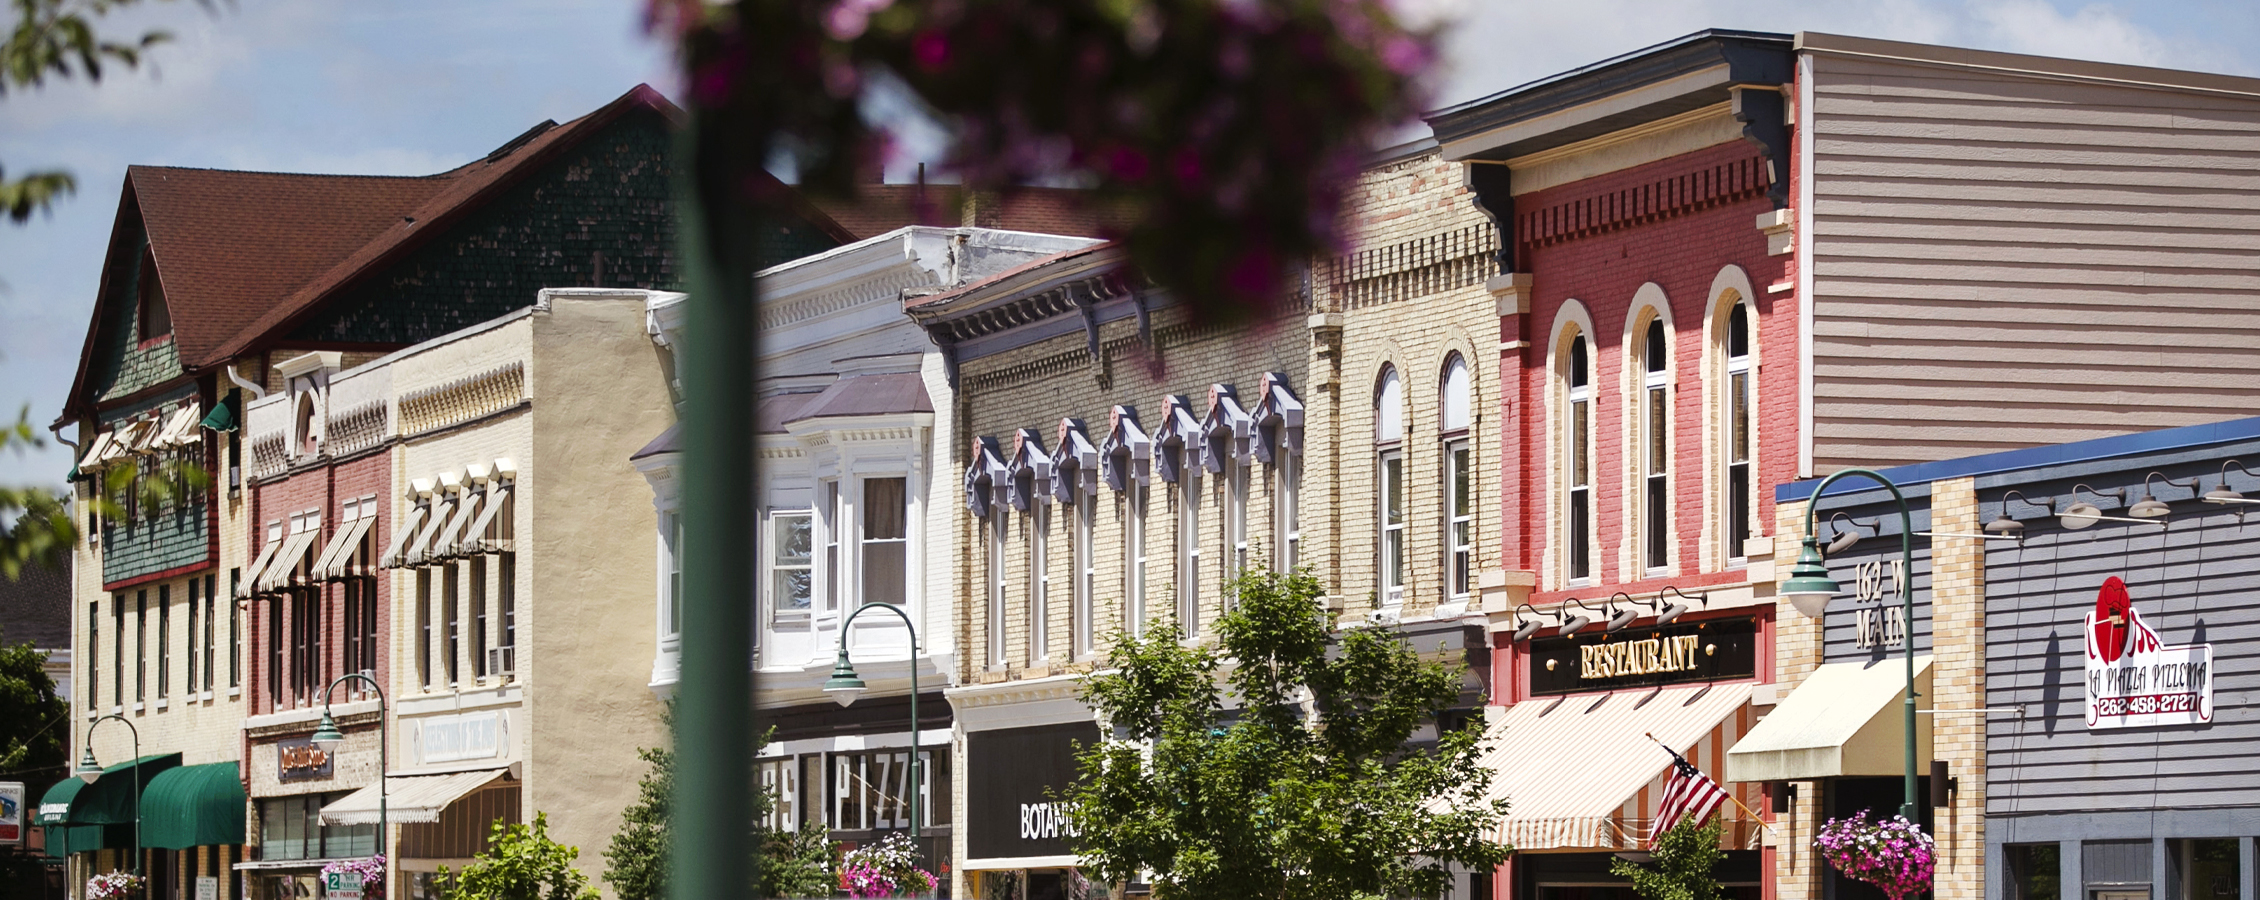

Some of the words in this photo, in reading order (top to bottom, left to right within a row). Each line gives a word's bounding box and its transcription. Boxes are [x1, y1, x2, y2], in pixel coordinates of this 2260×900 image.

[1855, 560, 1883, 603] 162
[1890, 559, 1907, 599] W
[1856, 606, 1907, 650] MAIN
[1580, 634, 1699, 680] RESTAURANT
[2088, 669, 2101, 699] LA
[2106, 665, 2147, 696] PIAZZA
[2151, 661, 2207, 692] PIZZERIA
[835, 751, 932, 831] PIZZA
[330, 874, 339, 888] 2
[330, 891, 338, 899] NO
[340, 891, 360, 899] PARKING
[340, 881, 360, 889] PARKING
